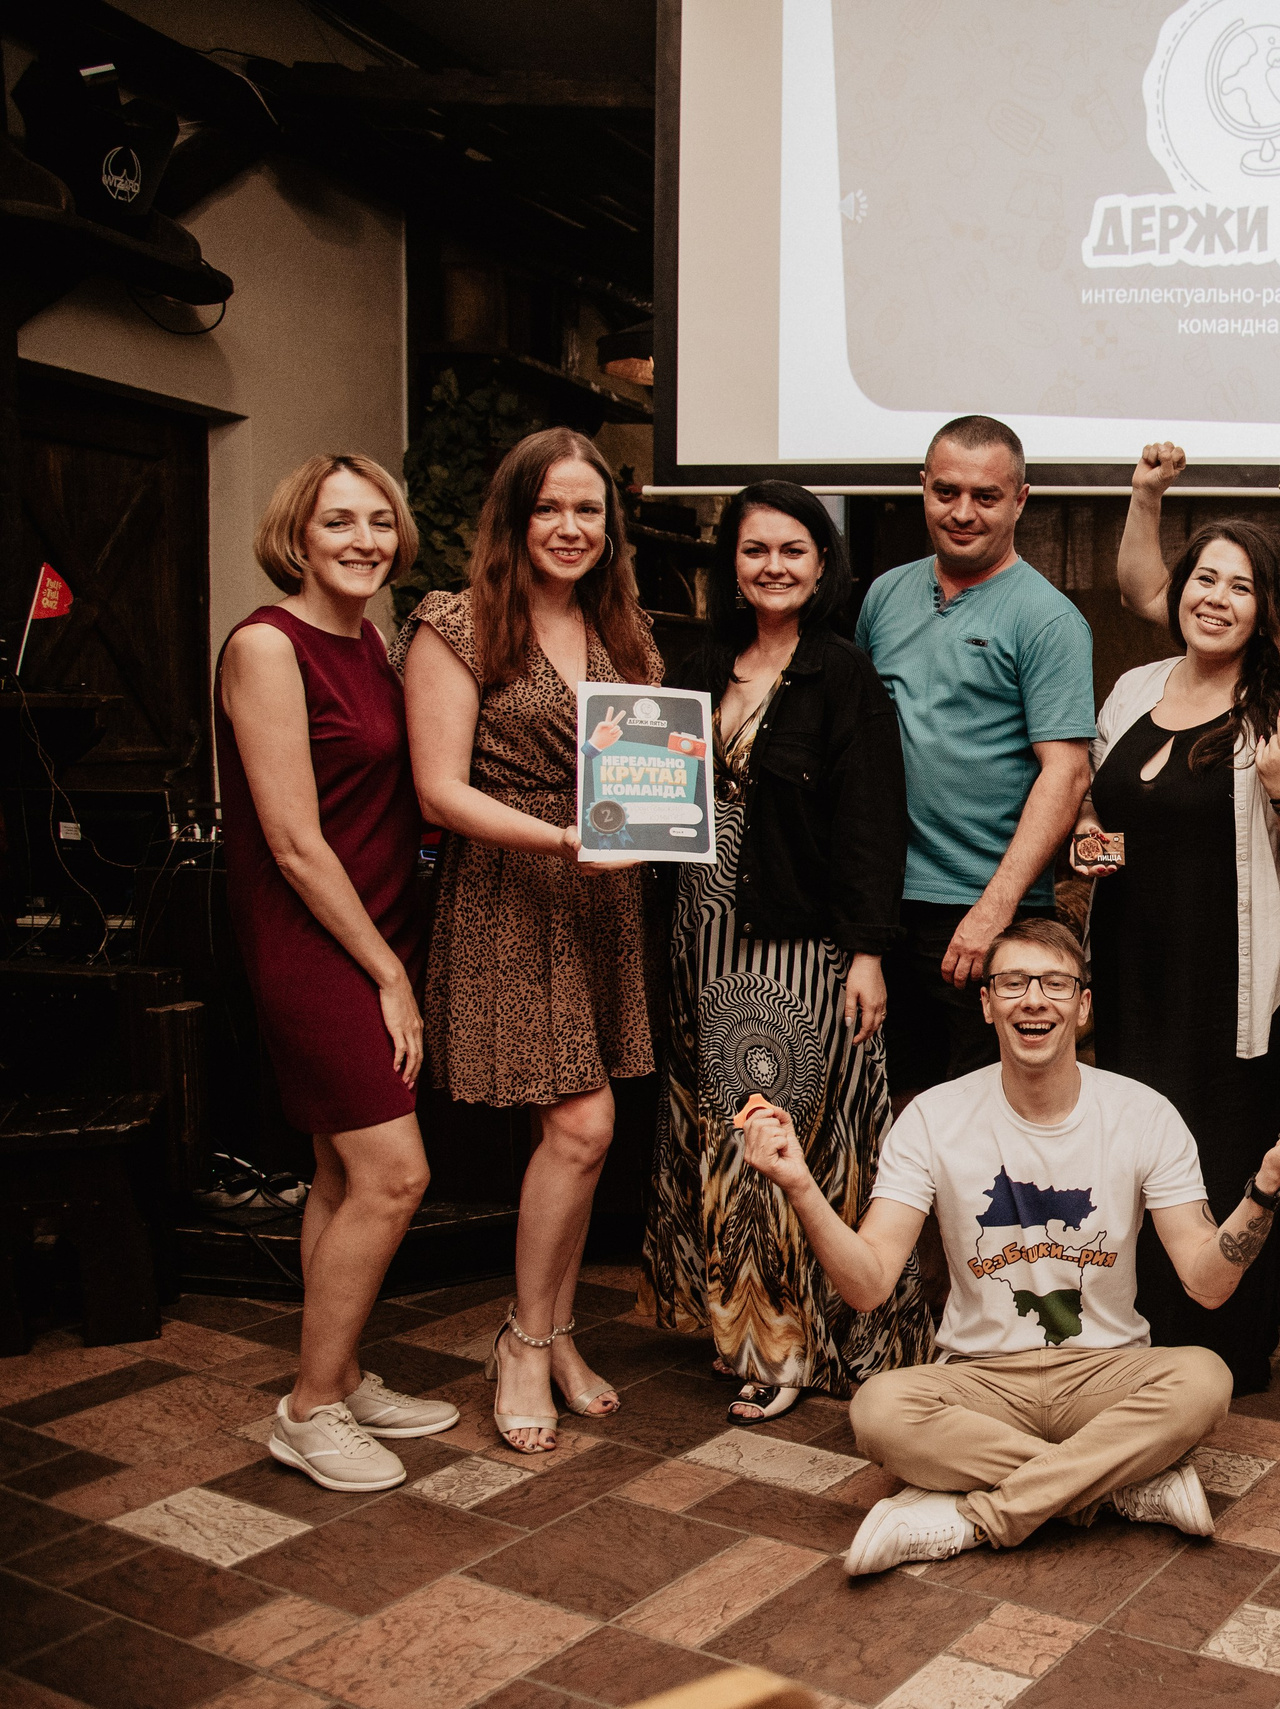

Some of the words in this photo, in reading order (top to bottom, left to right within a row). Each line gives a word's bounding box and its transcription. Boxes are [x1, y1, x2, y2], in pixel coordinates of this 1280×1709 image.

[1092, 203, 1269, 257] ДЕРЖИ
[601, 755, 686, 769] НЕРЕАЛЬНО
[600, 765, 688, 787] КРУТАЯ
[601, 783, 687, 799] КОМАНДА
[601, 809, 614, 823] 2
[1097, 854, 1122, 862] ПИЦЦА
